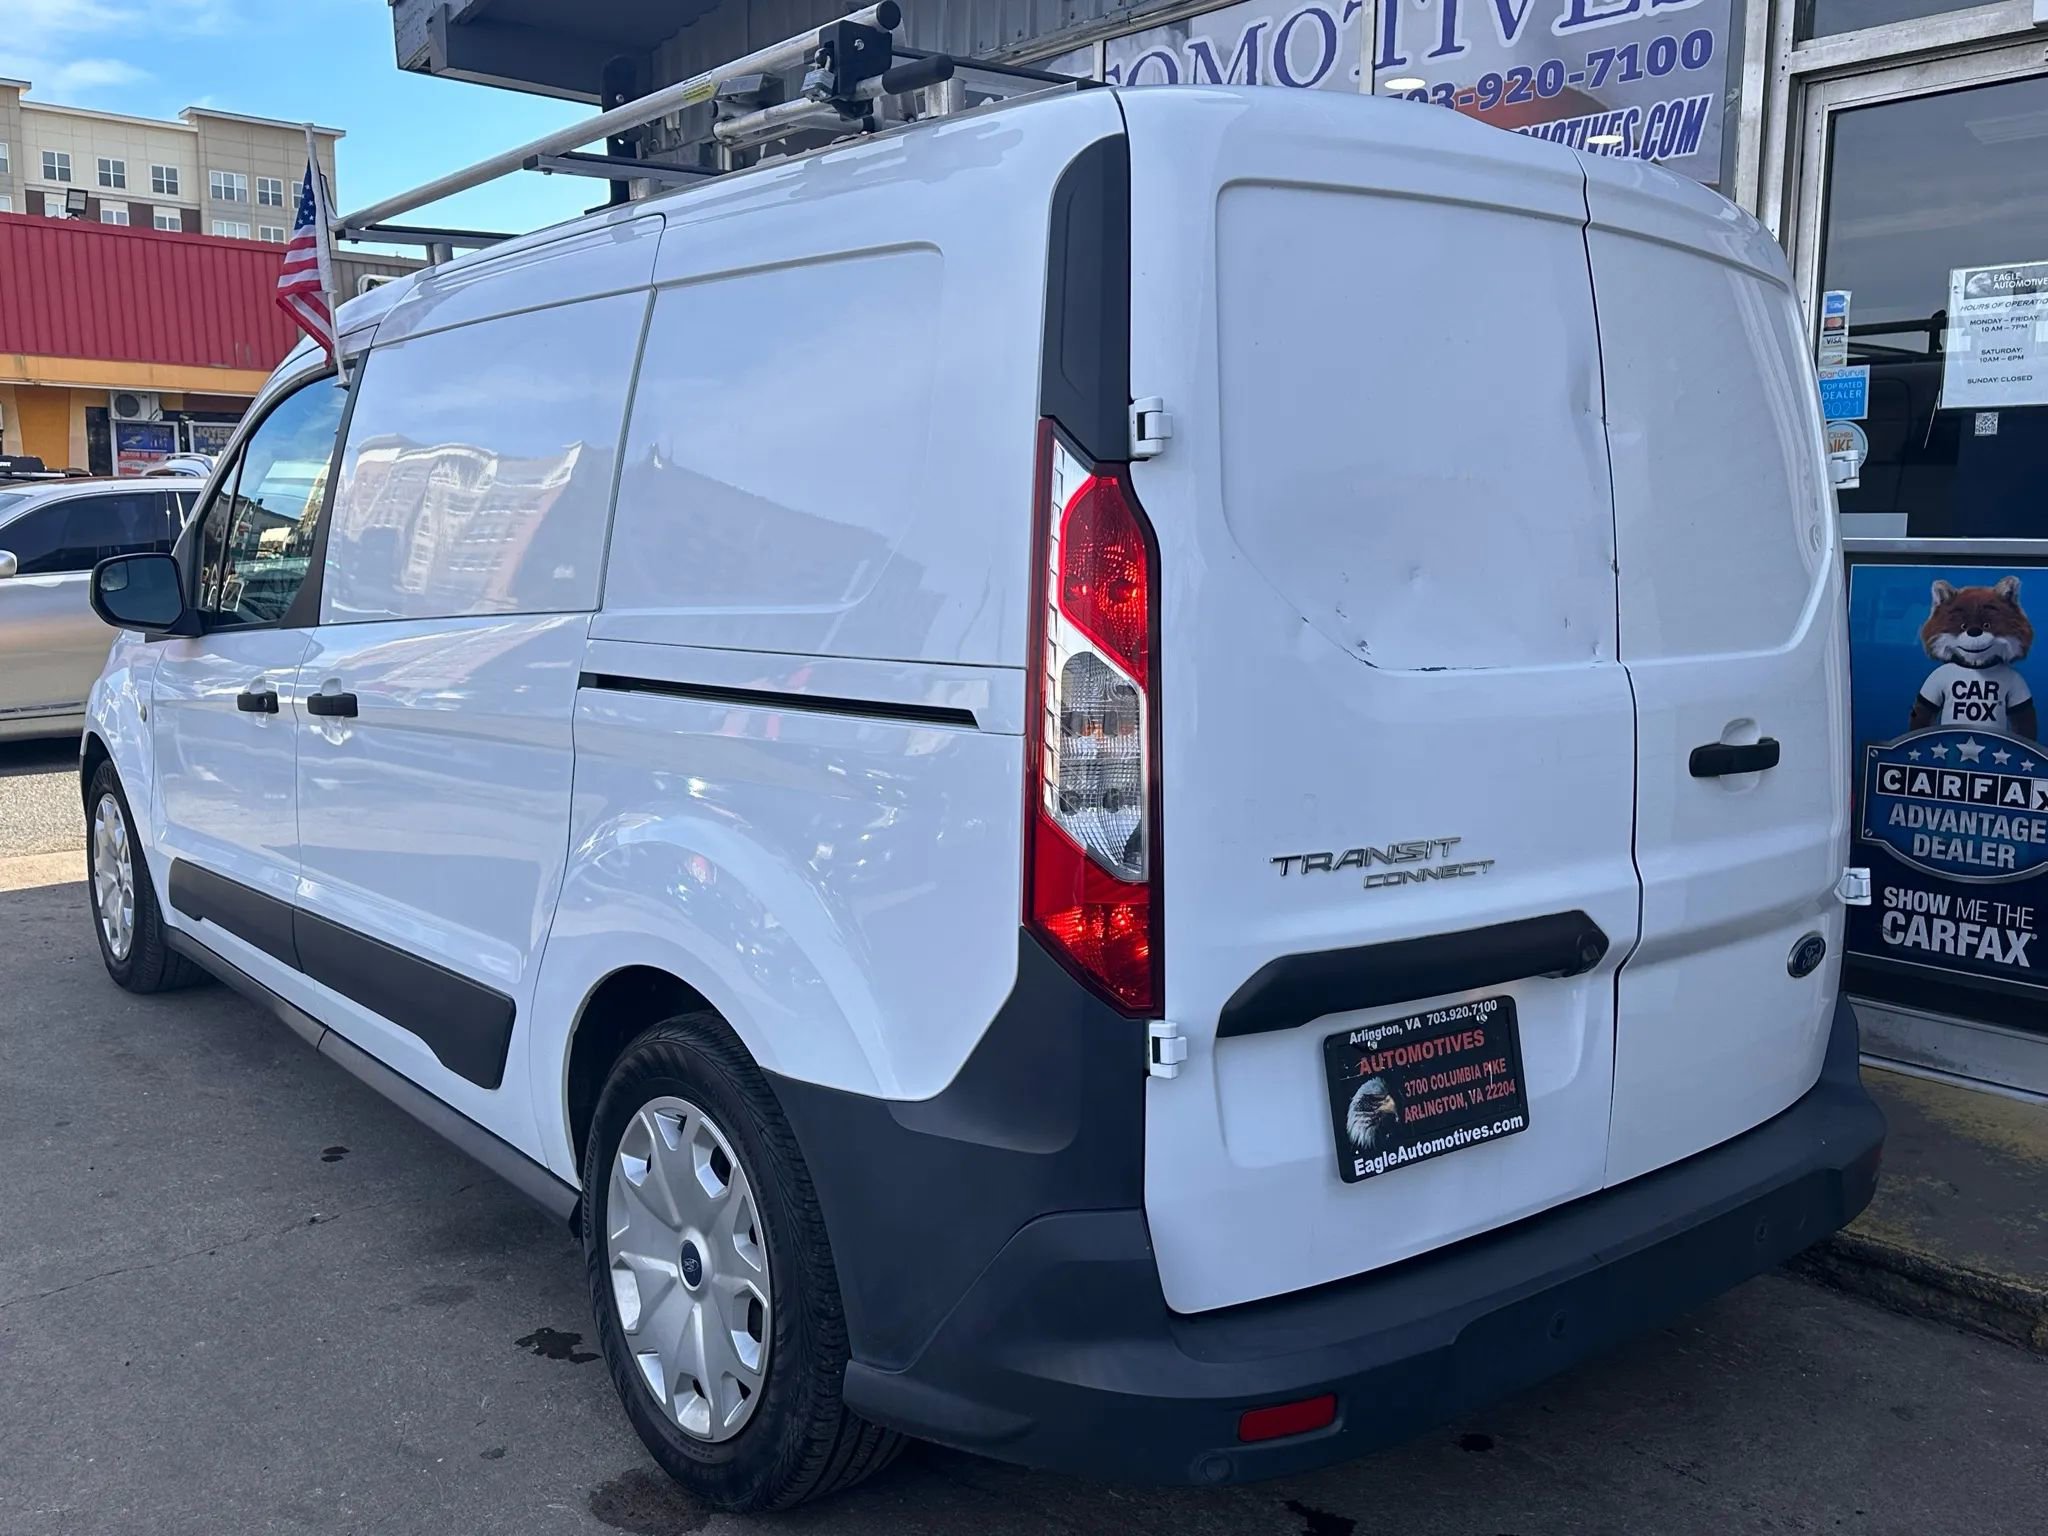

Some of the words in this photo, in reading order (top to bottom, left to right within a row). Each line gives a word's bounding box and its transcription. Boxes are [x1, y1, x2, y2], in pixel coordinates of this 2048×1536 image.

[1386, 29, 1713, 110] 3-920-7100
[1518, 97, 1710, 158] OTIVES.COM
[1993, 272, 2021, 282] EAGLE
[1960, 303, 1990, 311] HOURS
[1970, 317, 2003, 326] MONDAY
[1981, 347, 2023, 356] SATURDAY:
[1820, 369, 1866, 379] CarGurus
[1823, 383, 1838, 391] TOP
[1839, 381, 1863, 389] RATED
[2000, 374, 2033, 383] CLOSED
[1822, 389, 1862, 400] DEALER
[1823, 400, 1861, 417] 2021
[195, 427, 234, 438] JOYER
[1951, 679, 2000, 701] CAR
[1952, 701, 1998, 722] FOX
[1888, 802, 2047, 844] ADVANTAGE
[1269, 836, 1462, 877] TRANSIT
[1913, 833, 2016, 869] DEALER
[1363, 859, 1496, 889] CONNECT
[1882, 886, 1950, 917] SHOW
[1956, 897, 1990, 923] ME
[1993, 902, 2035, 931] THE
[1349, 1021, 1403, 1045] Arlington,
[1405, 1016, 1422, 1031] VA
[1426, 999, 1498, 1027] 703.920.7100
[1359, 1029, 1486, 1076] AUTOMOTIVES
[1404, 1077, 1429, 1099] 3700
[1430, 1065, 1482, 1092] COLUMBIA
[1484, 1057, 1507, 1079] PIKE
[1404, 1094, 1469, 1125] ARLINGTON,
[1468, 1087, 1484, 1106] VA
[1486, 1078, 1516, 1102] 22204
[1354, 1115, 1524, 1177] EagleAutomotives.com
